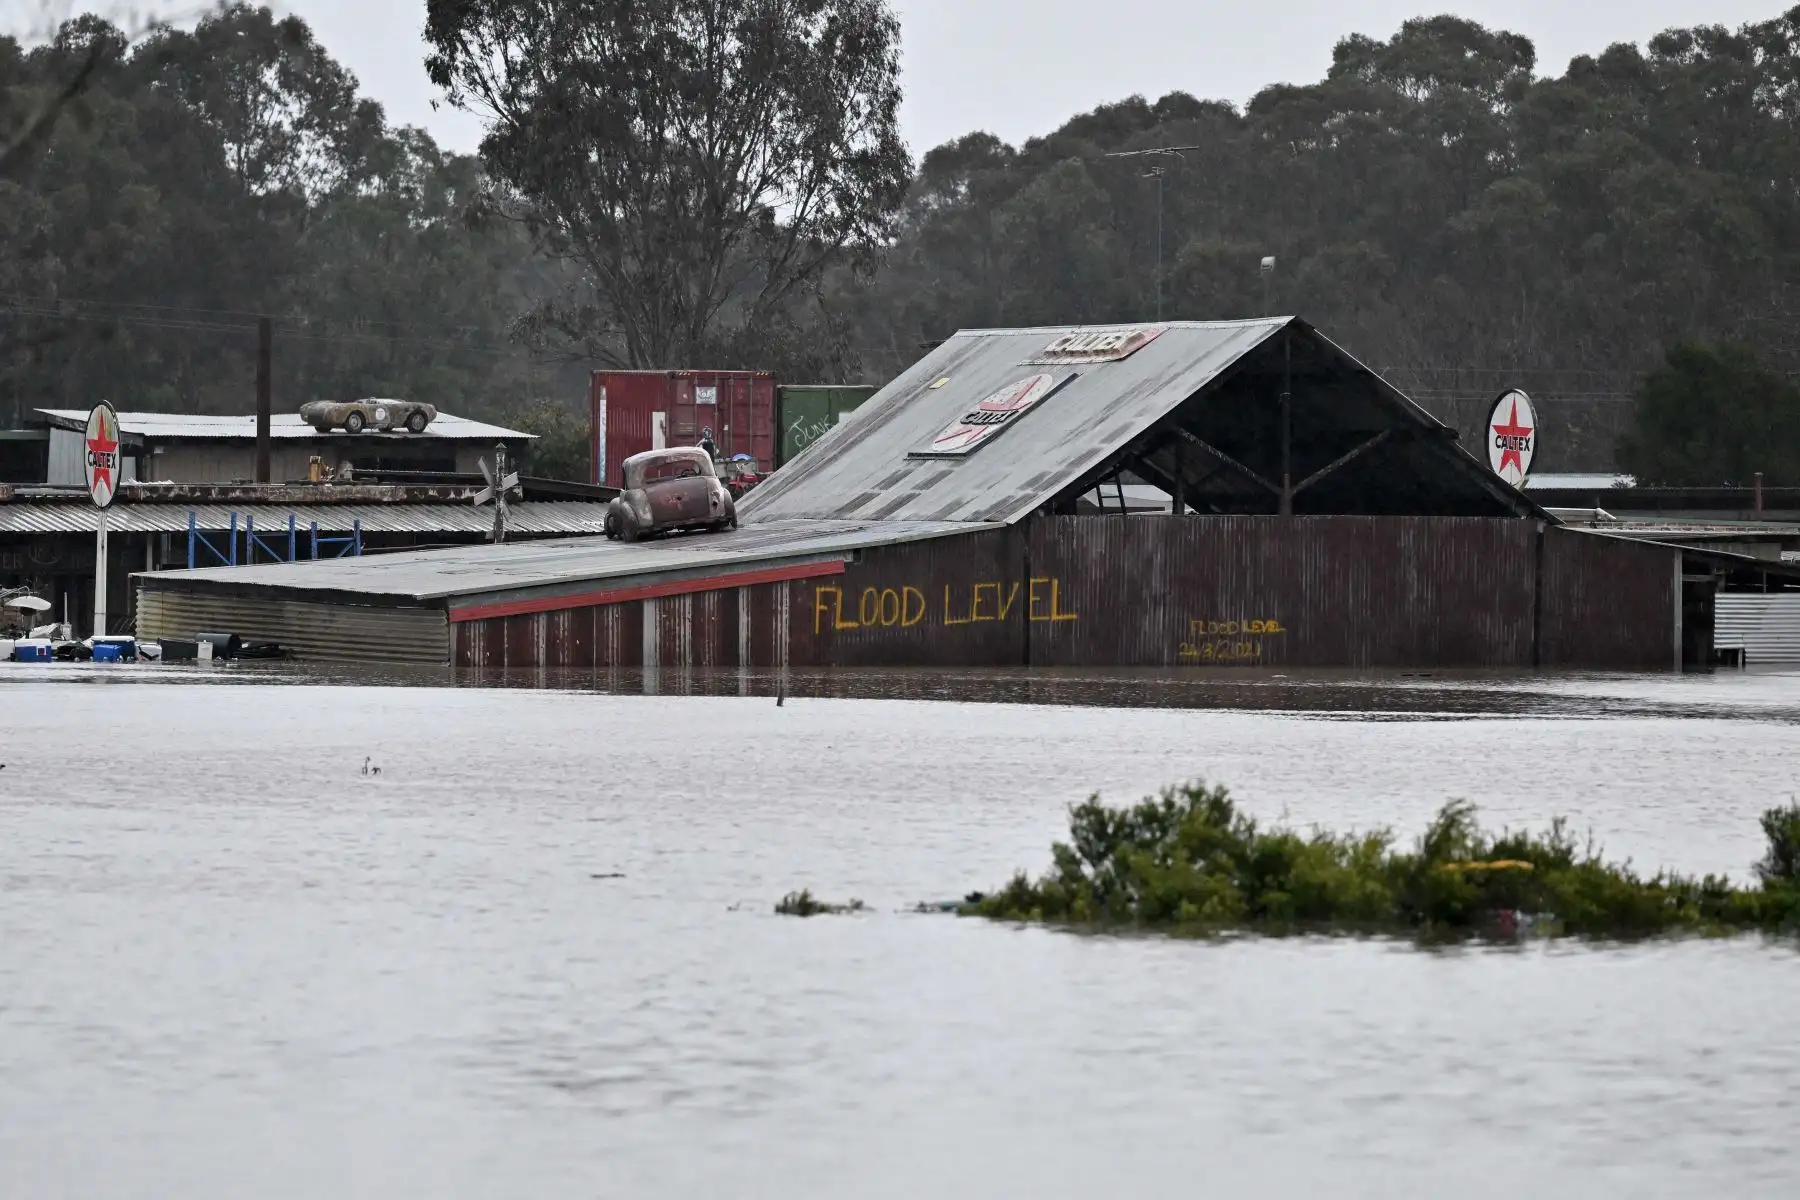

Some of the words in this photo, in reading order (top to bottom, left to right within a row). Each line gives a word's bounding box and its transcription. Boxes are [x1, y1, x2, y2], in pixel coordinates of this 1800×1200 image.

[1495, 434, 1531, 452] CALTEX
[87, 449, 117, 469] CALTEX
[813, 585, 926, 634] FLOOD
[944, 577, 1078, 625] LEVEL
[1190, 619, 1240, 635] FLOOD
[1242, 619, 1287, 633] LEVEL
